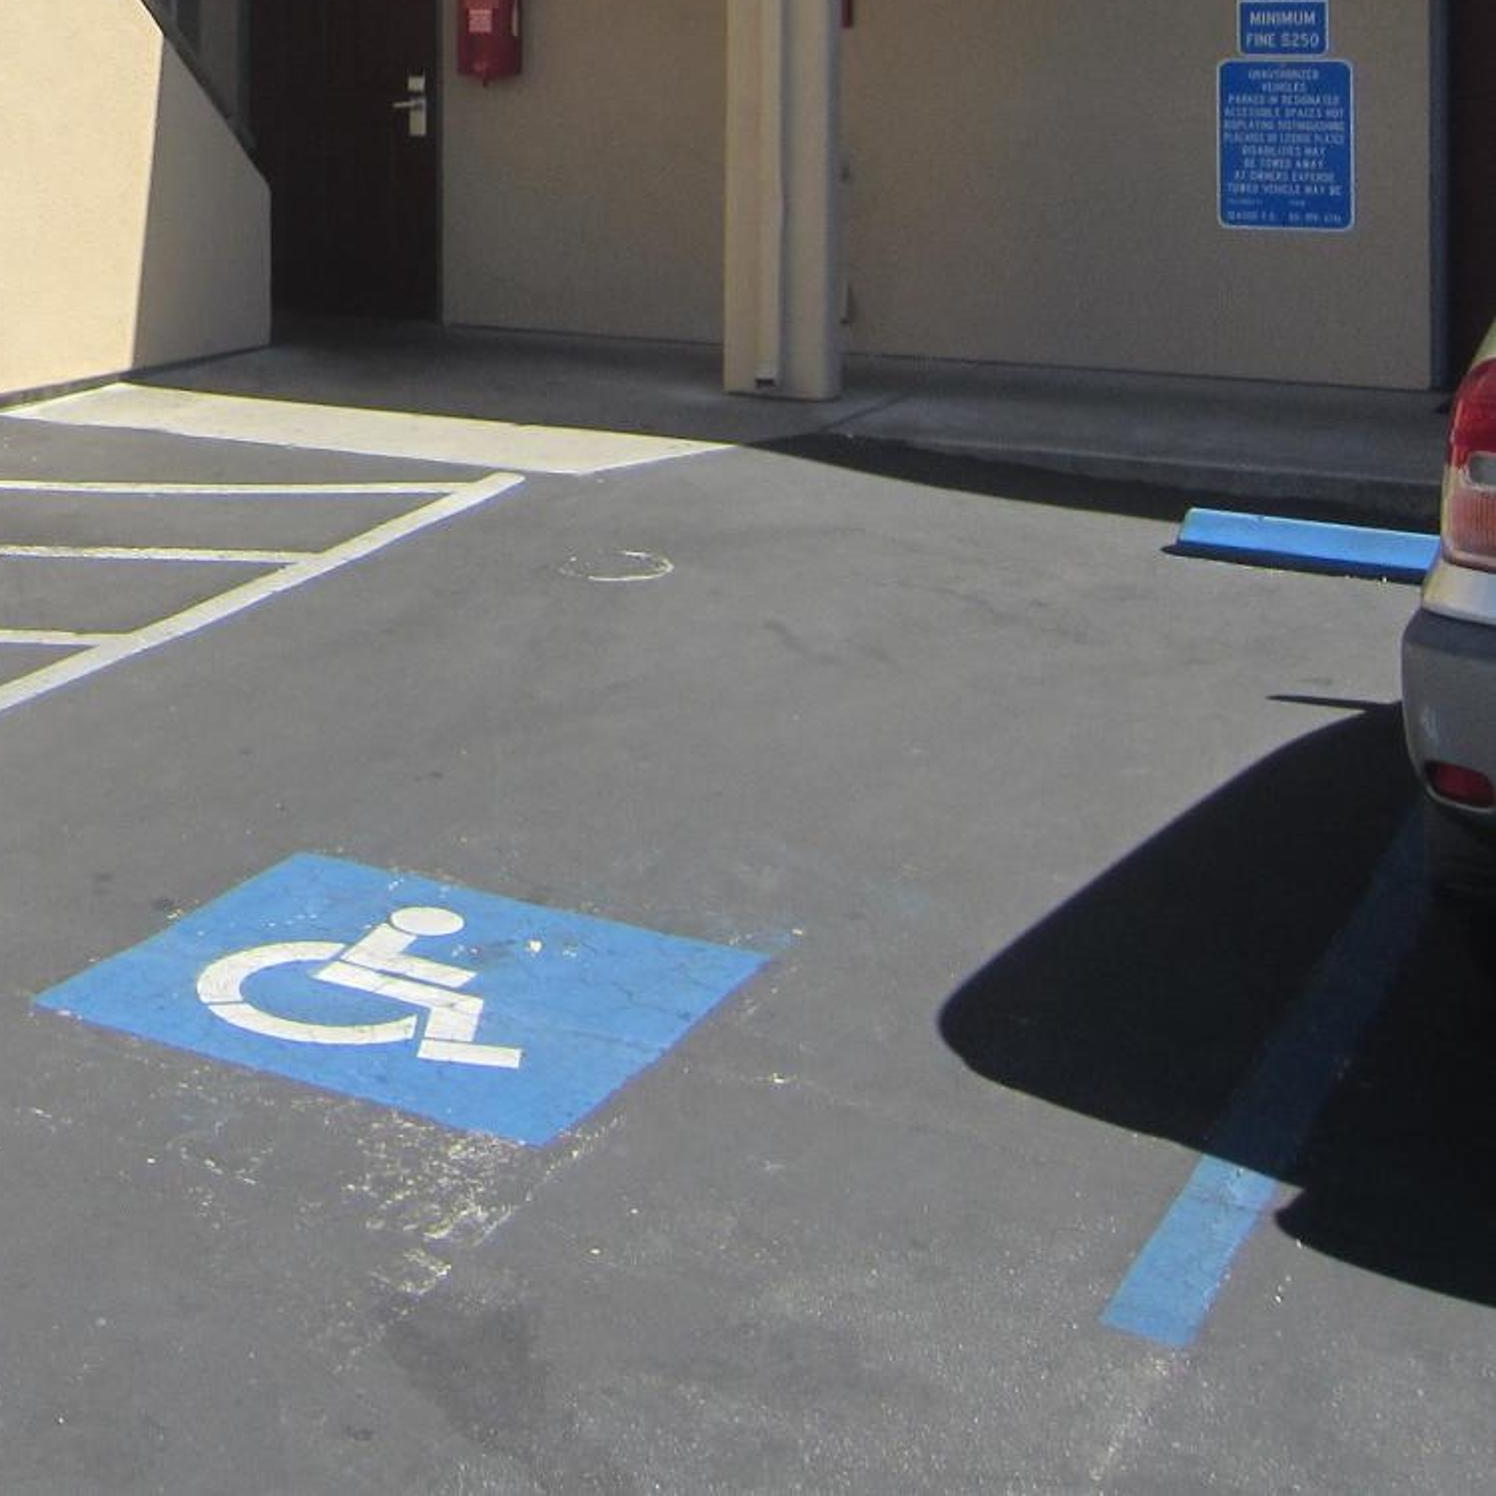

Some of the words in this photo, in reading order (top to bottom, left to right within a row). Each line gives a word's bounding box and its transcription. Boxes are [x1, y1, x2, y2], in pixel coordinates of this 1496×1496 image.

[1250, 11, 1315, 25] MINIMUM
[1246, 33, 1276, 48] FINE
[1281, 33, 1319, 48] $250
[1228, 94, 1265, 104] PARKED
[1281, 94, 1340, 104] DESIGNATED
[1224, 107, 1280, 117] ACCESSIBLE
[1285, 107, 1322, 117] SPACES
[1326, 108, 1344, 118] NOT
[1224, 120, 1274, 129] DISPLAYING
[1304, 146, 1326, 157] MAY
[1244, 159, 1255, 168] BE
[1260, 159, 1292, 169] TOWED
[1295, 159, 1326, 168] AWAY
[1235, 171, 1245, 181] AT
[1292, 171, 1335, 183] EXPENSE
[1227, 183, 1259, 194] TOWED
[1305, 185, 1325, 195] MAY
[1329, 185, 1343, 196] BE
